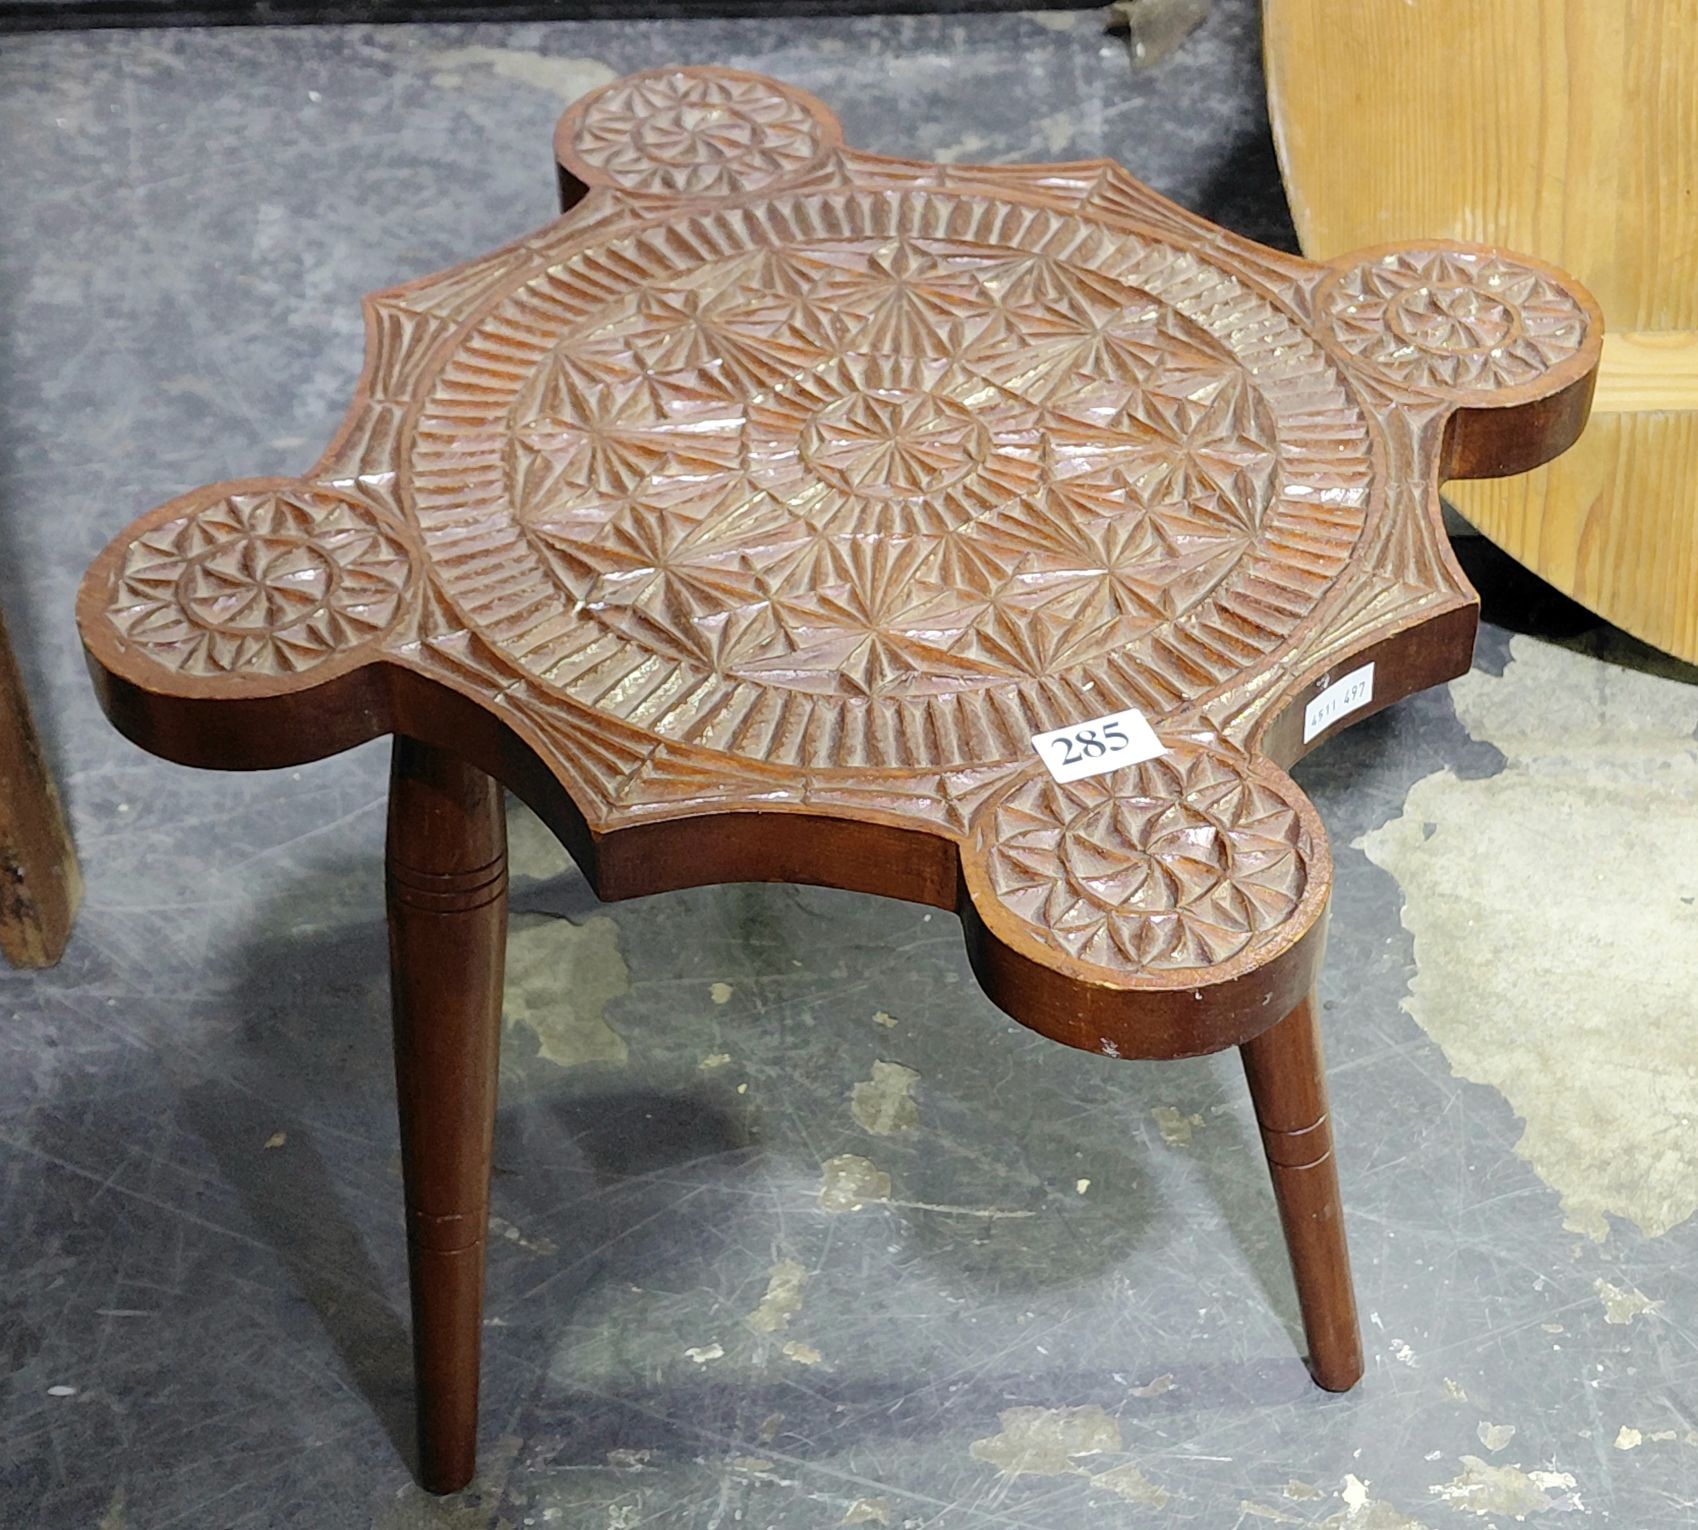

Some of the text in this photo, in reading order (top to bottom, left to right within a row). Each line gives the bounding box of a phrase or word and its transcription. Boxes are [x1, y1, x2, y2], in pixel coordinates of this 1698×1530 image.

[1311, 681, 1366, 726] 4511 497
[1050, 721, 1130, 766] 285
